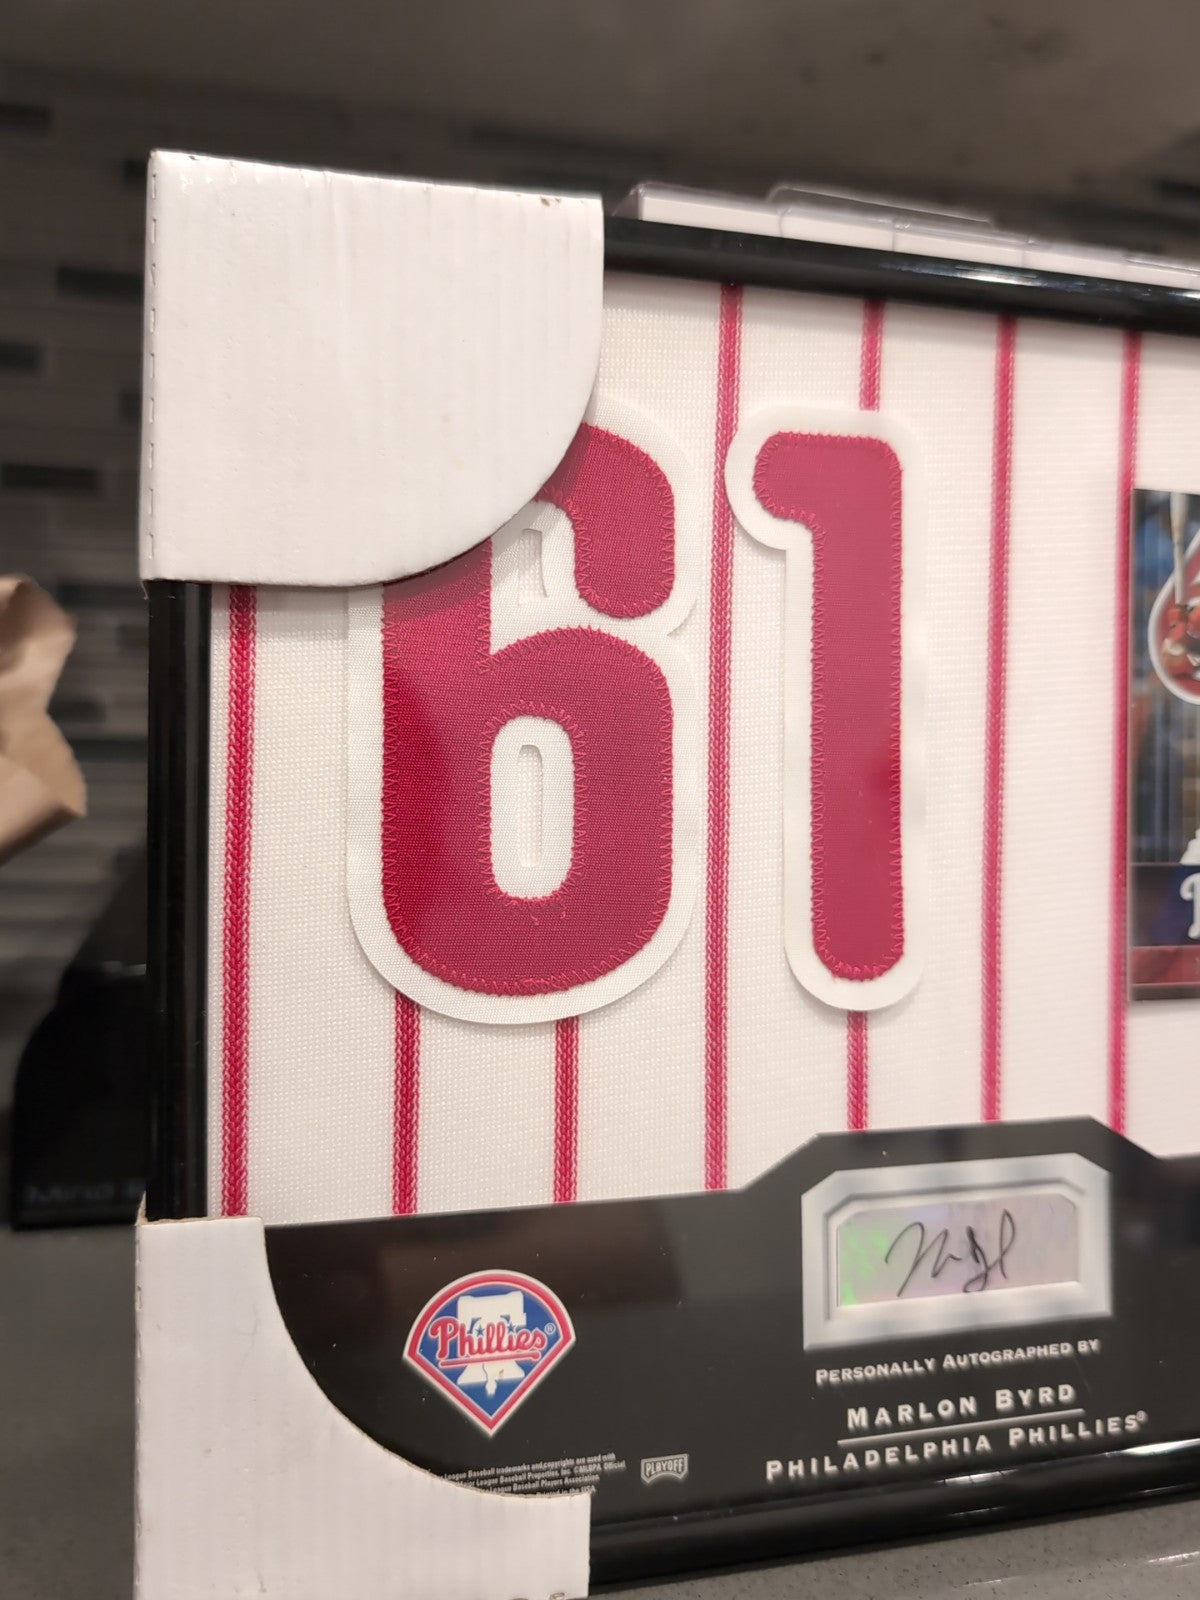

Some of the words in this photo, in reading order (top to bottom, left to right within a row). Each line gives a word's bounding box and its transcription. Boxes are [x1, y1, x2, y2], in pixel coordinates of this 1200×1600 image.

[815, 1357, 935, 1386] PERSONALLY
[942, 1341, 1071, 1370] AUTOGRAPHED
[1077, 1338, 1100, 1354] BY
[846, 1394, 977, 1431] MARLON
[995, 1382, 1077, 1412] BYRD
[468, 1467, 495, 1478] Baseball
[645, 1458, 684, 1477] PLAYOFF
[766, 1434, 992, 1483] PHILADELPHIA
[500, 1473, 527, 1484] Baseball
